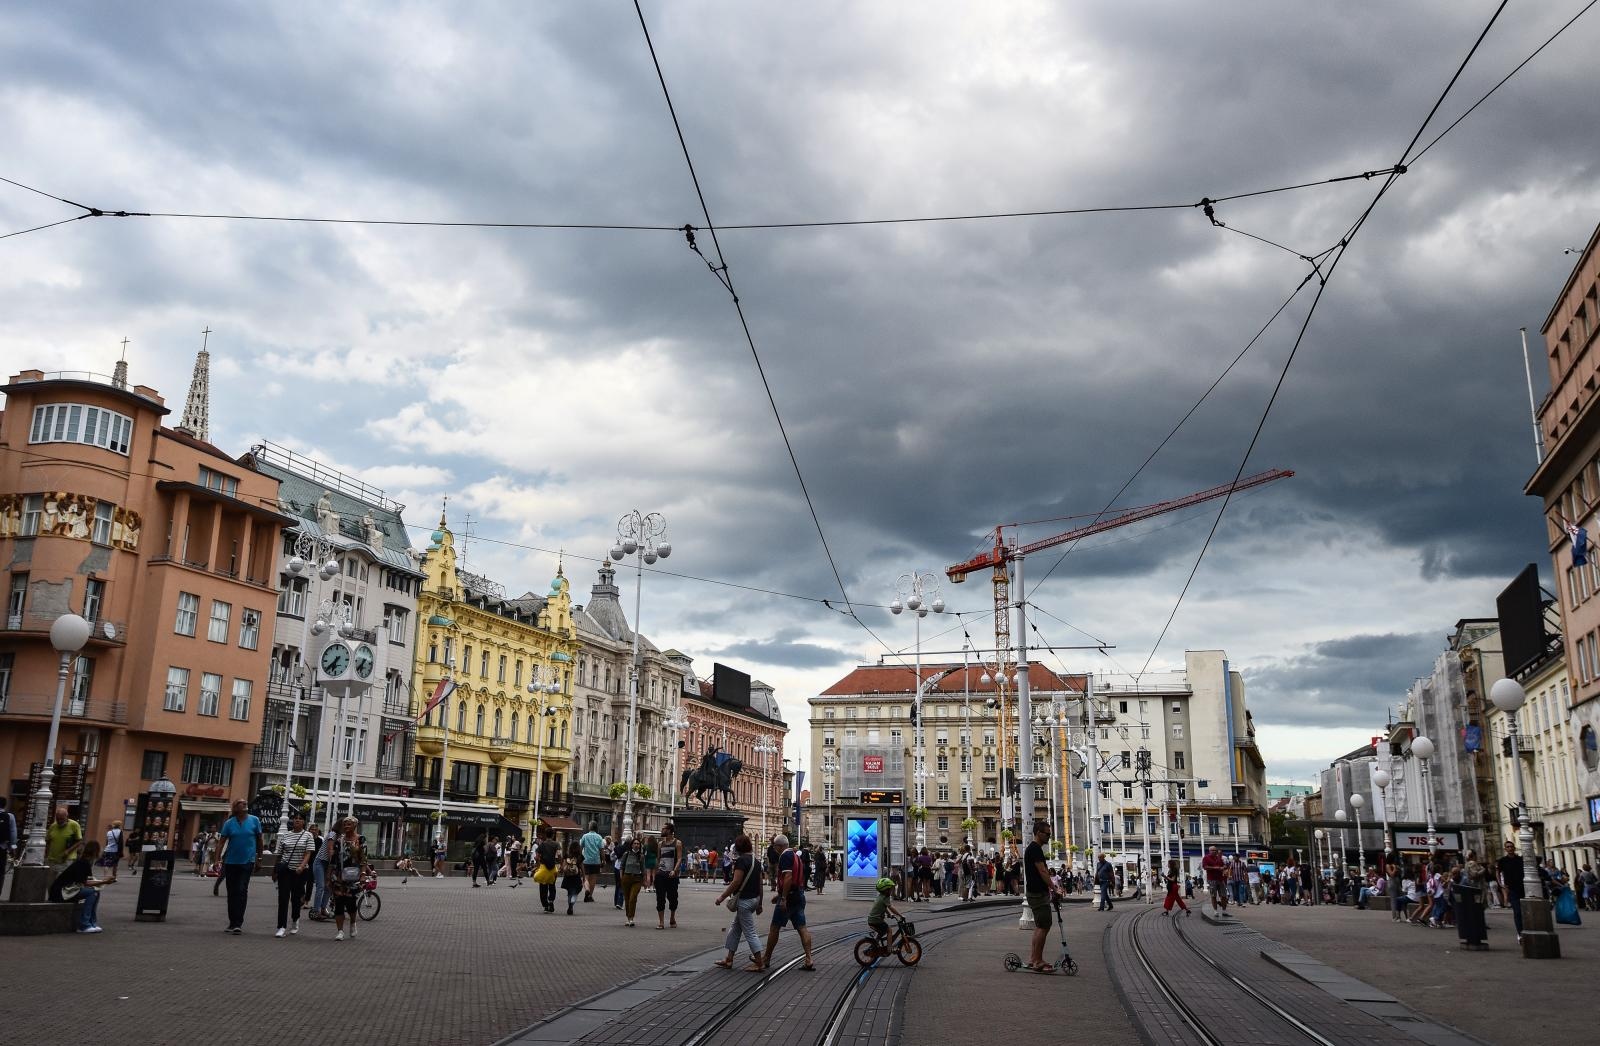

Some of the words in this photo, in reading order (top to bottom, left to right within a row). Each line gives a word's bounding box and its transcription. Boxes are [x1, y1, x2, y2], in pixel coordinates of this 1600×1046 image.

[260, 809, 279, 817] MALA
[260, 816, 282, 824] AVANA
[1408, 836, 1445, 846] TISK
